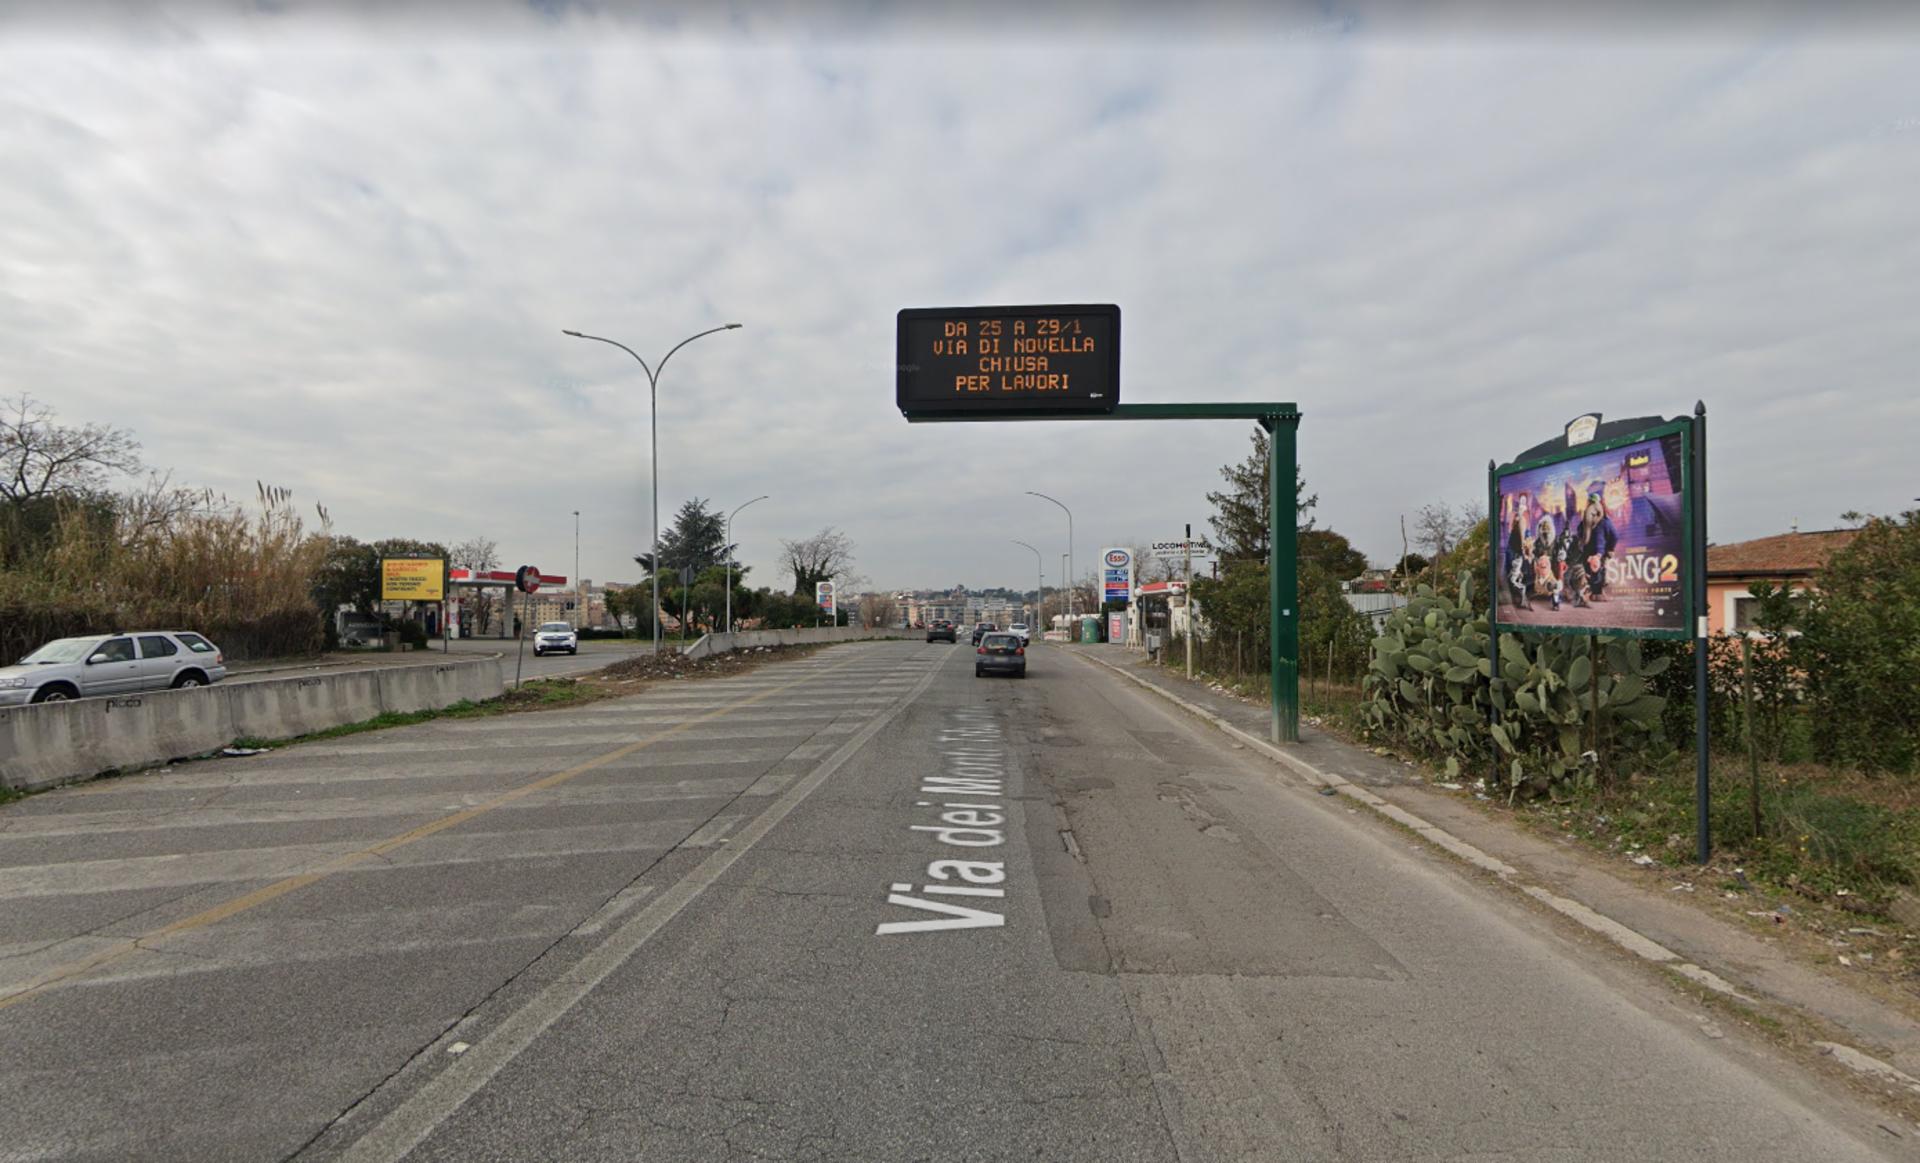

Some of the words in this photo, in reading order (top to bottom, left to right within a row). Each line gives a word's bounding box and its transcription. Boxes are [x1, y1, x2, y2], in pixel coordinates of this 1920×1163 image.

[945, 321, 967, 337] DA
[979, 320, 1002, 336] 25
[1014, 320, 1025, 335] A
[1038, 319, 1082, 335] 29/1
[933, 339, 967, 355] VIA
[979, 339, 999, 354] DI
[1014, 337, 1095, 353] NOVELLA
[979, 356, 1049, 373] CHIUSA
[955, 375, 991, 391] PER
[1001, 374, 1070, 390] LAVORI
